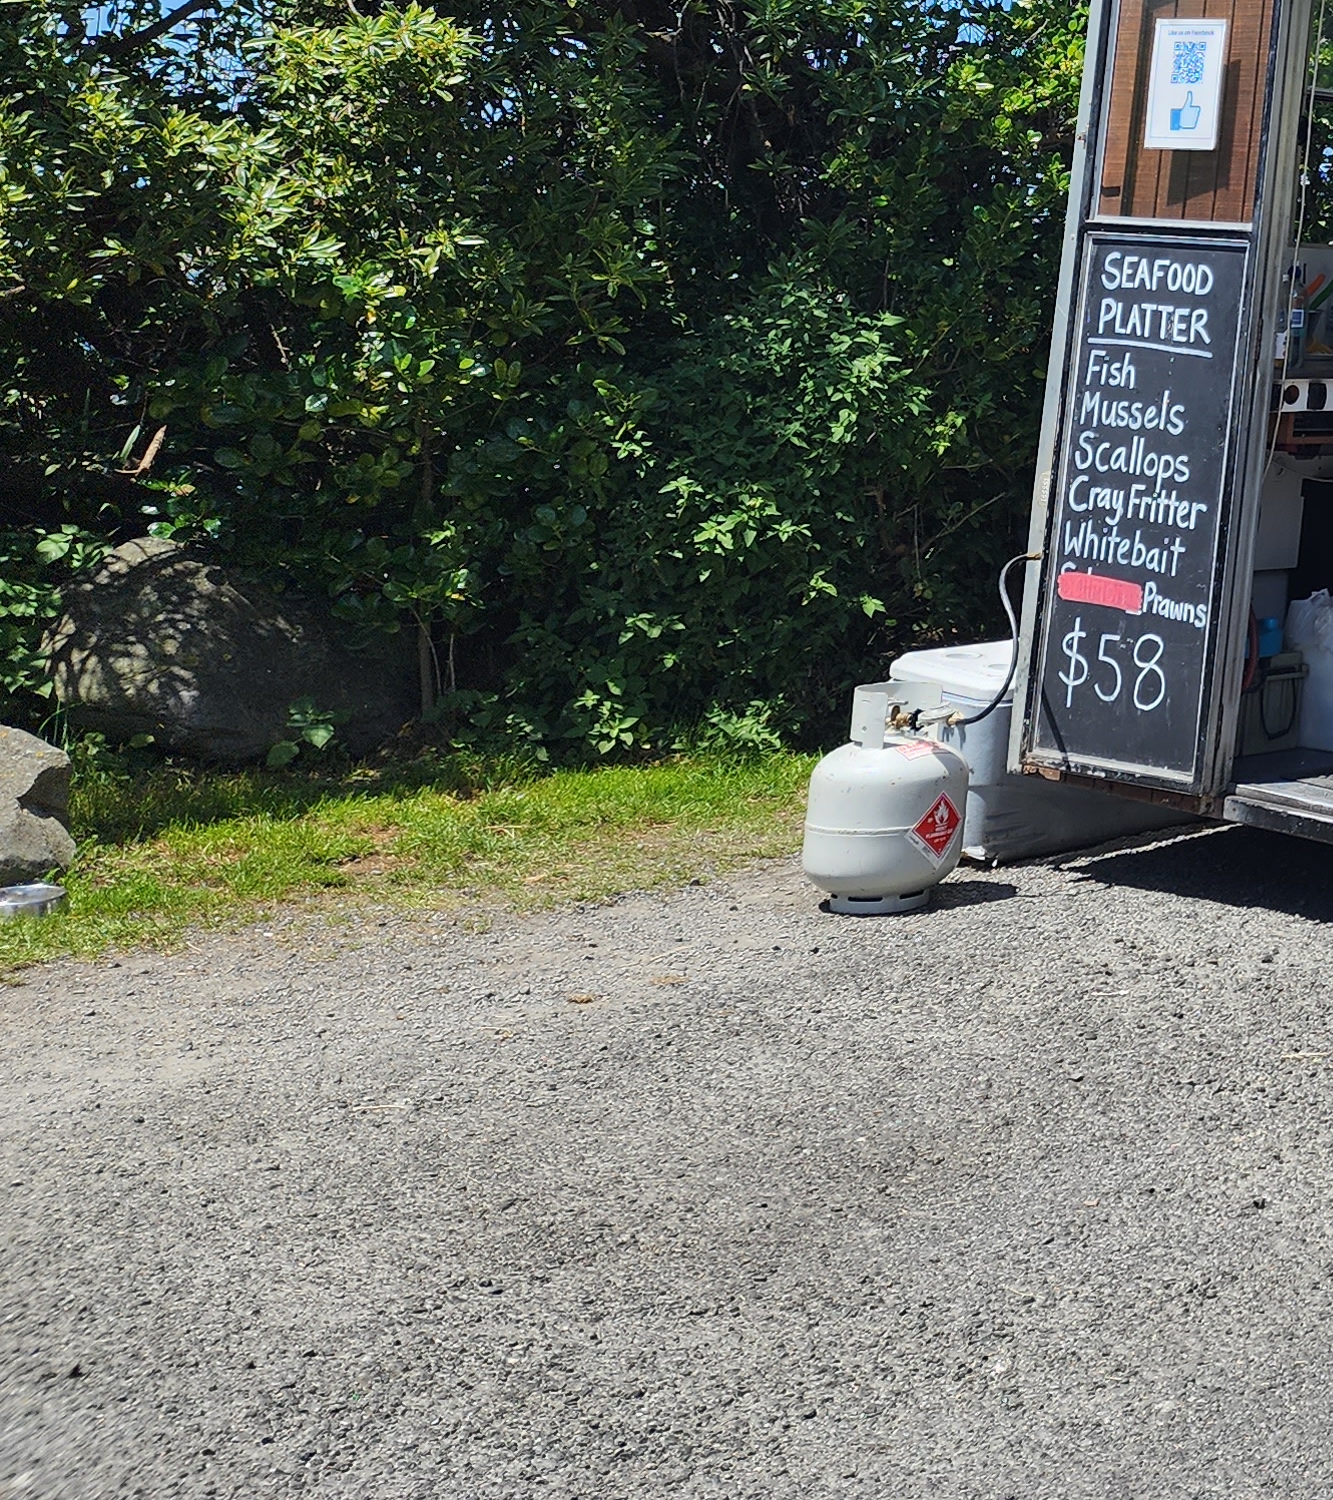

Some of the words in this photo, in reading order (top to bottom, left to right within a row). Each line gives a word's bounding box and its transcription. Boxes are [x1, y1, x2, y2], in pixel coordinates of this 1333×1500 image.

[1100, 251, 1213, 295] SEAFOOD
[1097, 298, 1212, 345] PLATTER
[1085, 351, 1135, 390] Fish
[1080, 391, 1185, 435] Mussels
[1073, 431, 1190, 484] Scallops
[1069, 476, 1124, 525] Cray
[1126, 484, 1207, 531] Fritter
[1063, 520, 1186, 577] Whitebait
[1143, 581, 1207, 628] Prawns
[1058, 617, 1166, 711] $58
